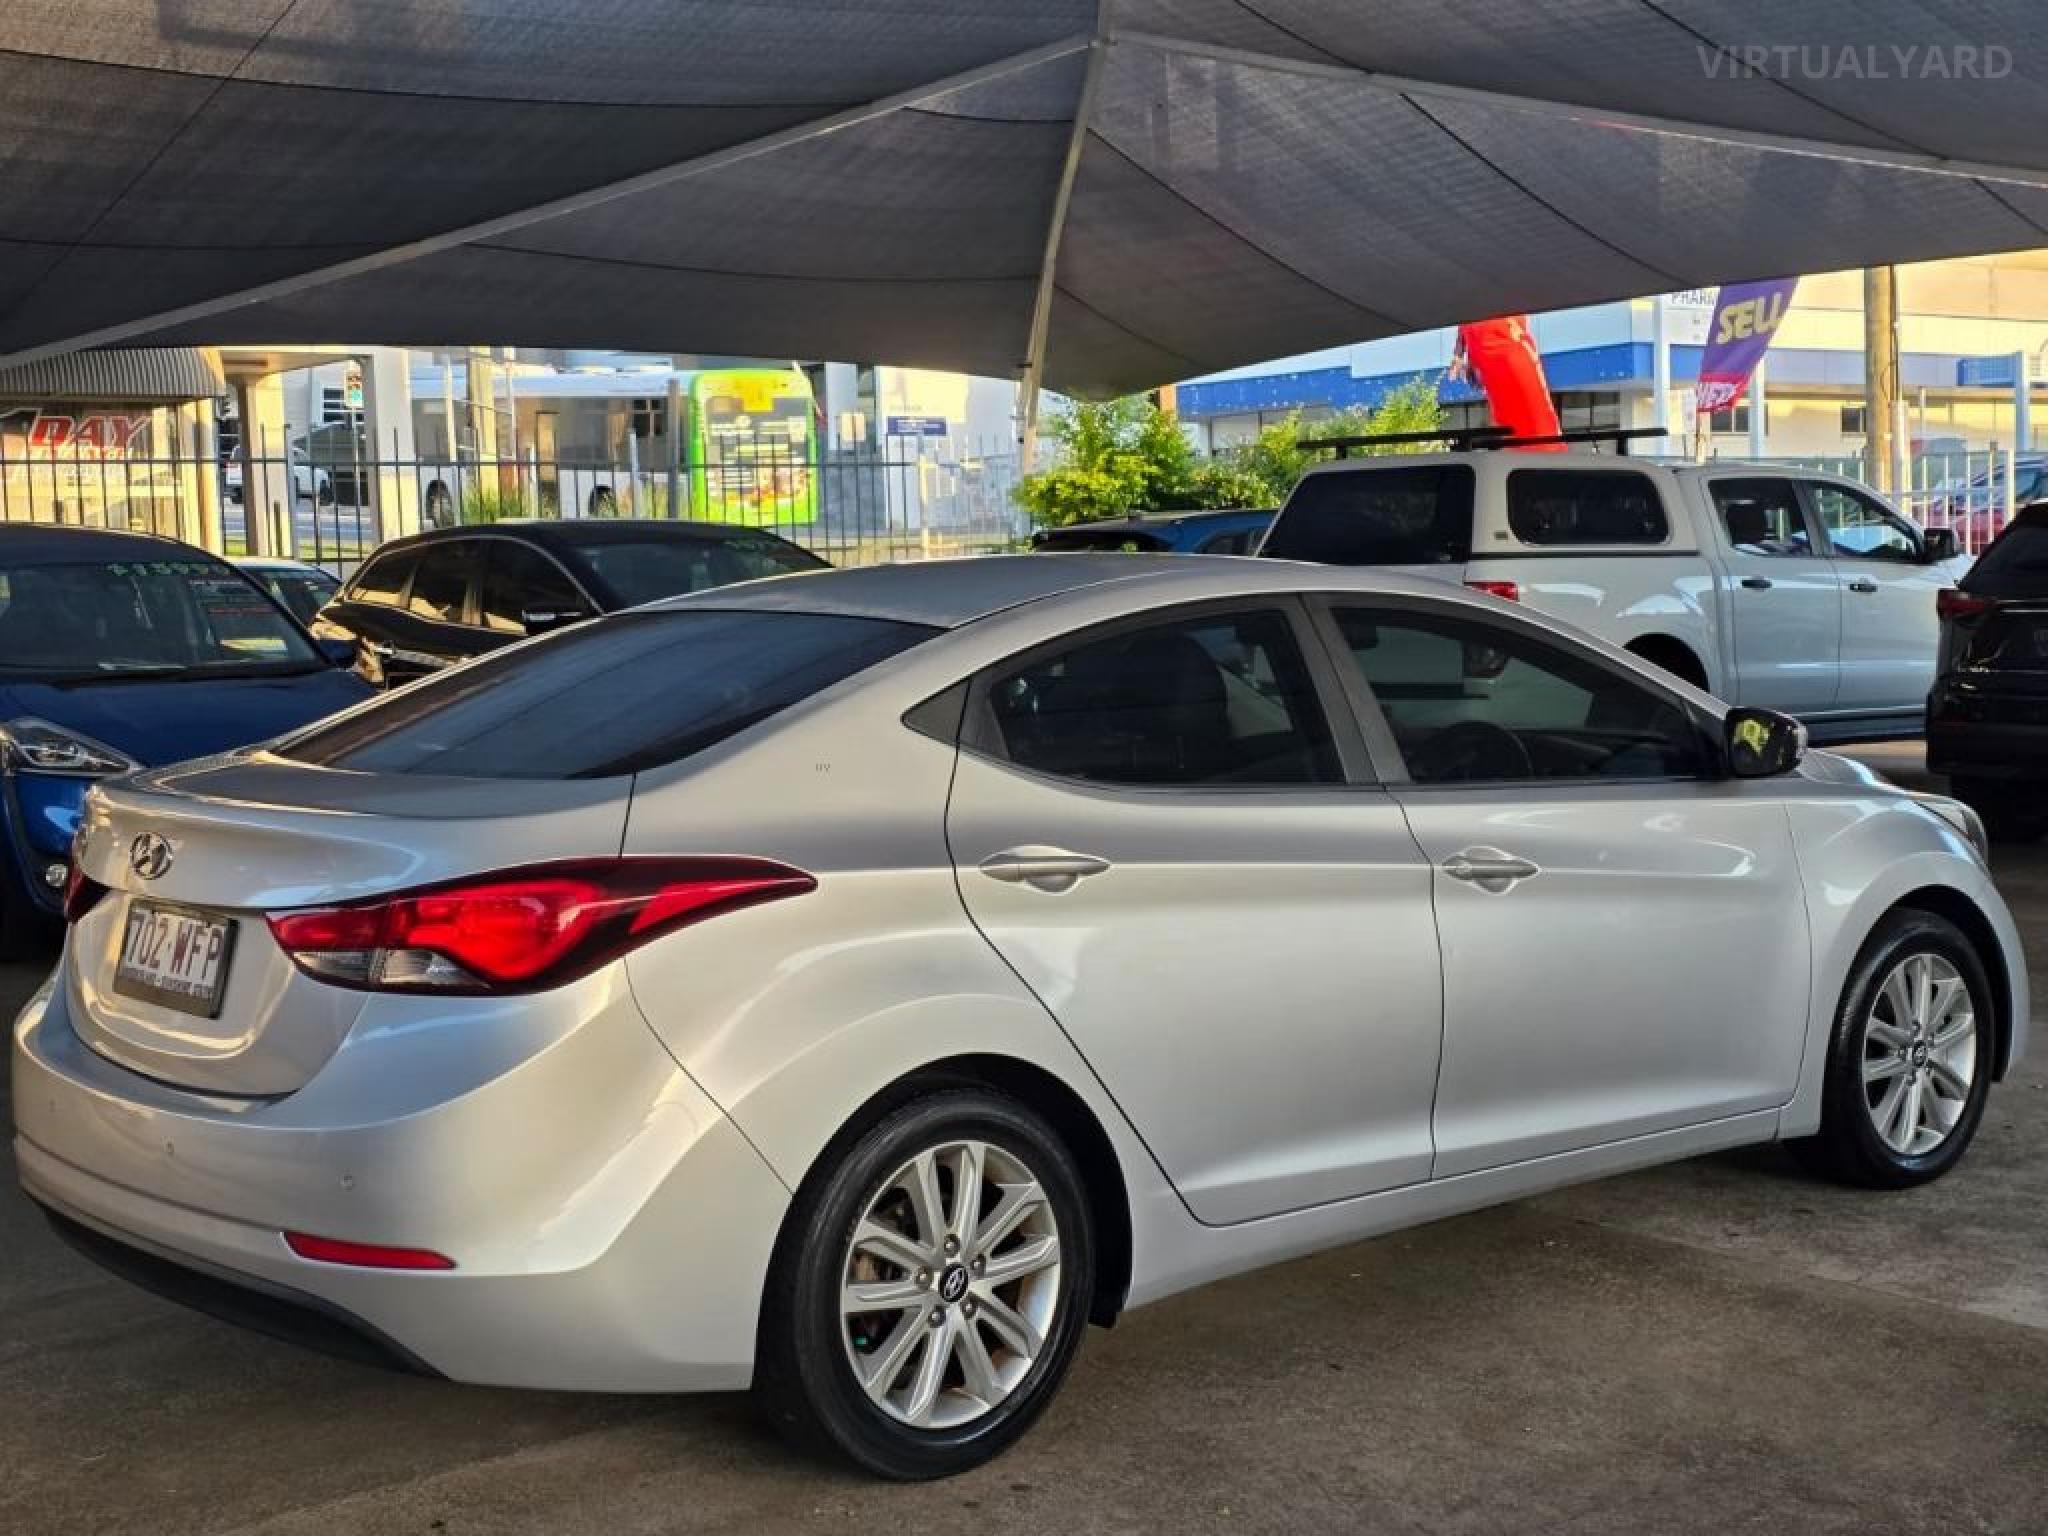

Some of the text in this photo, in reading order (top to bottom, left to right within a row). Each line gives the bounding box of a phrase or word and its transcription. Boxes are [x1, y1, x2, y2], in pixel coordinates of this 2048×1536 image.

[1716, 293, 1783, 345] SELL
[28, 416, 152, 450] DAY
[127, 910, 225, 980] 702 WFP
